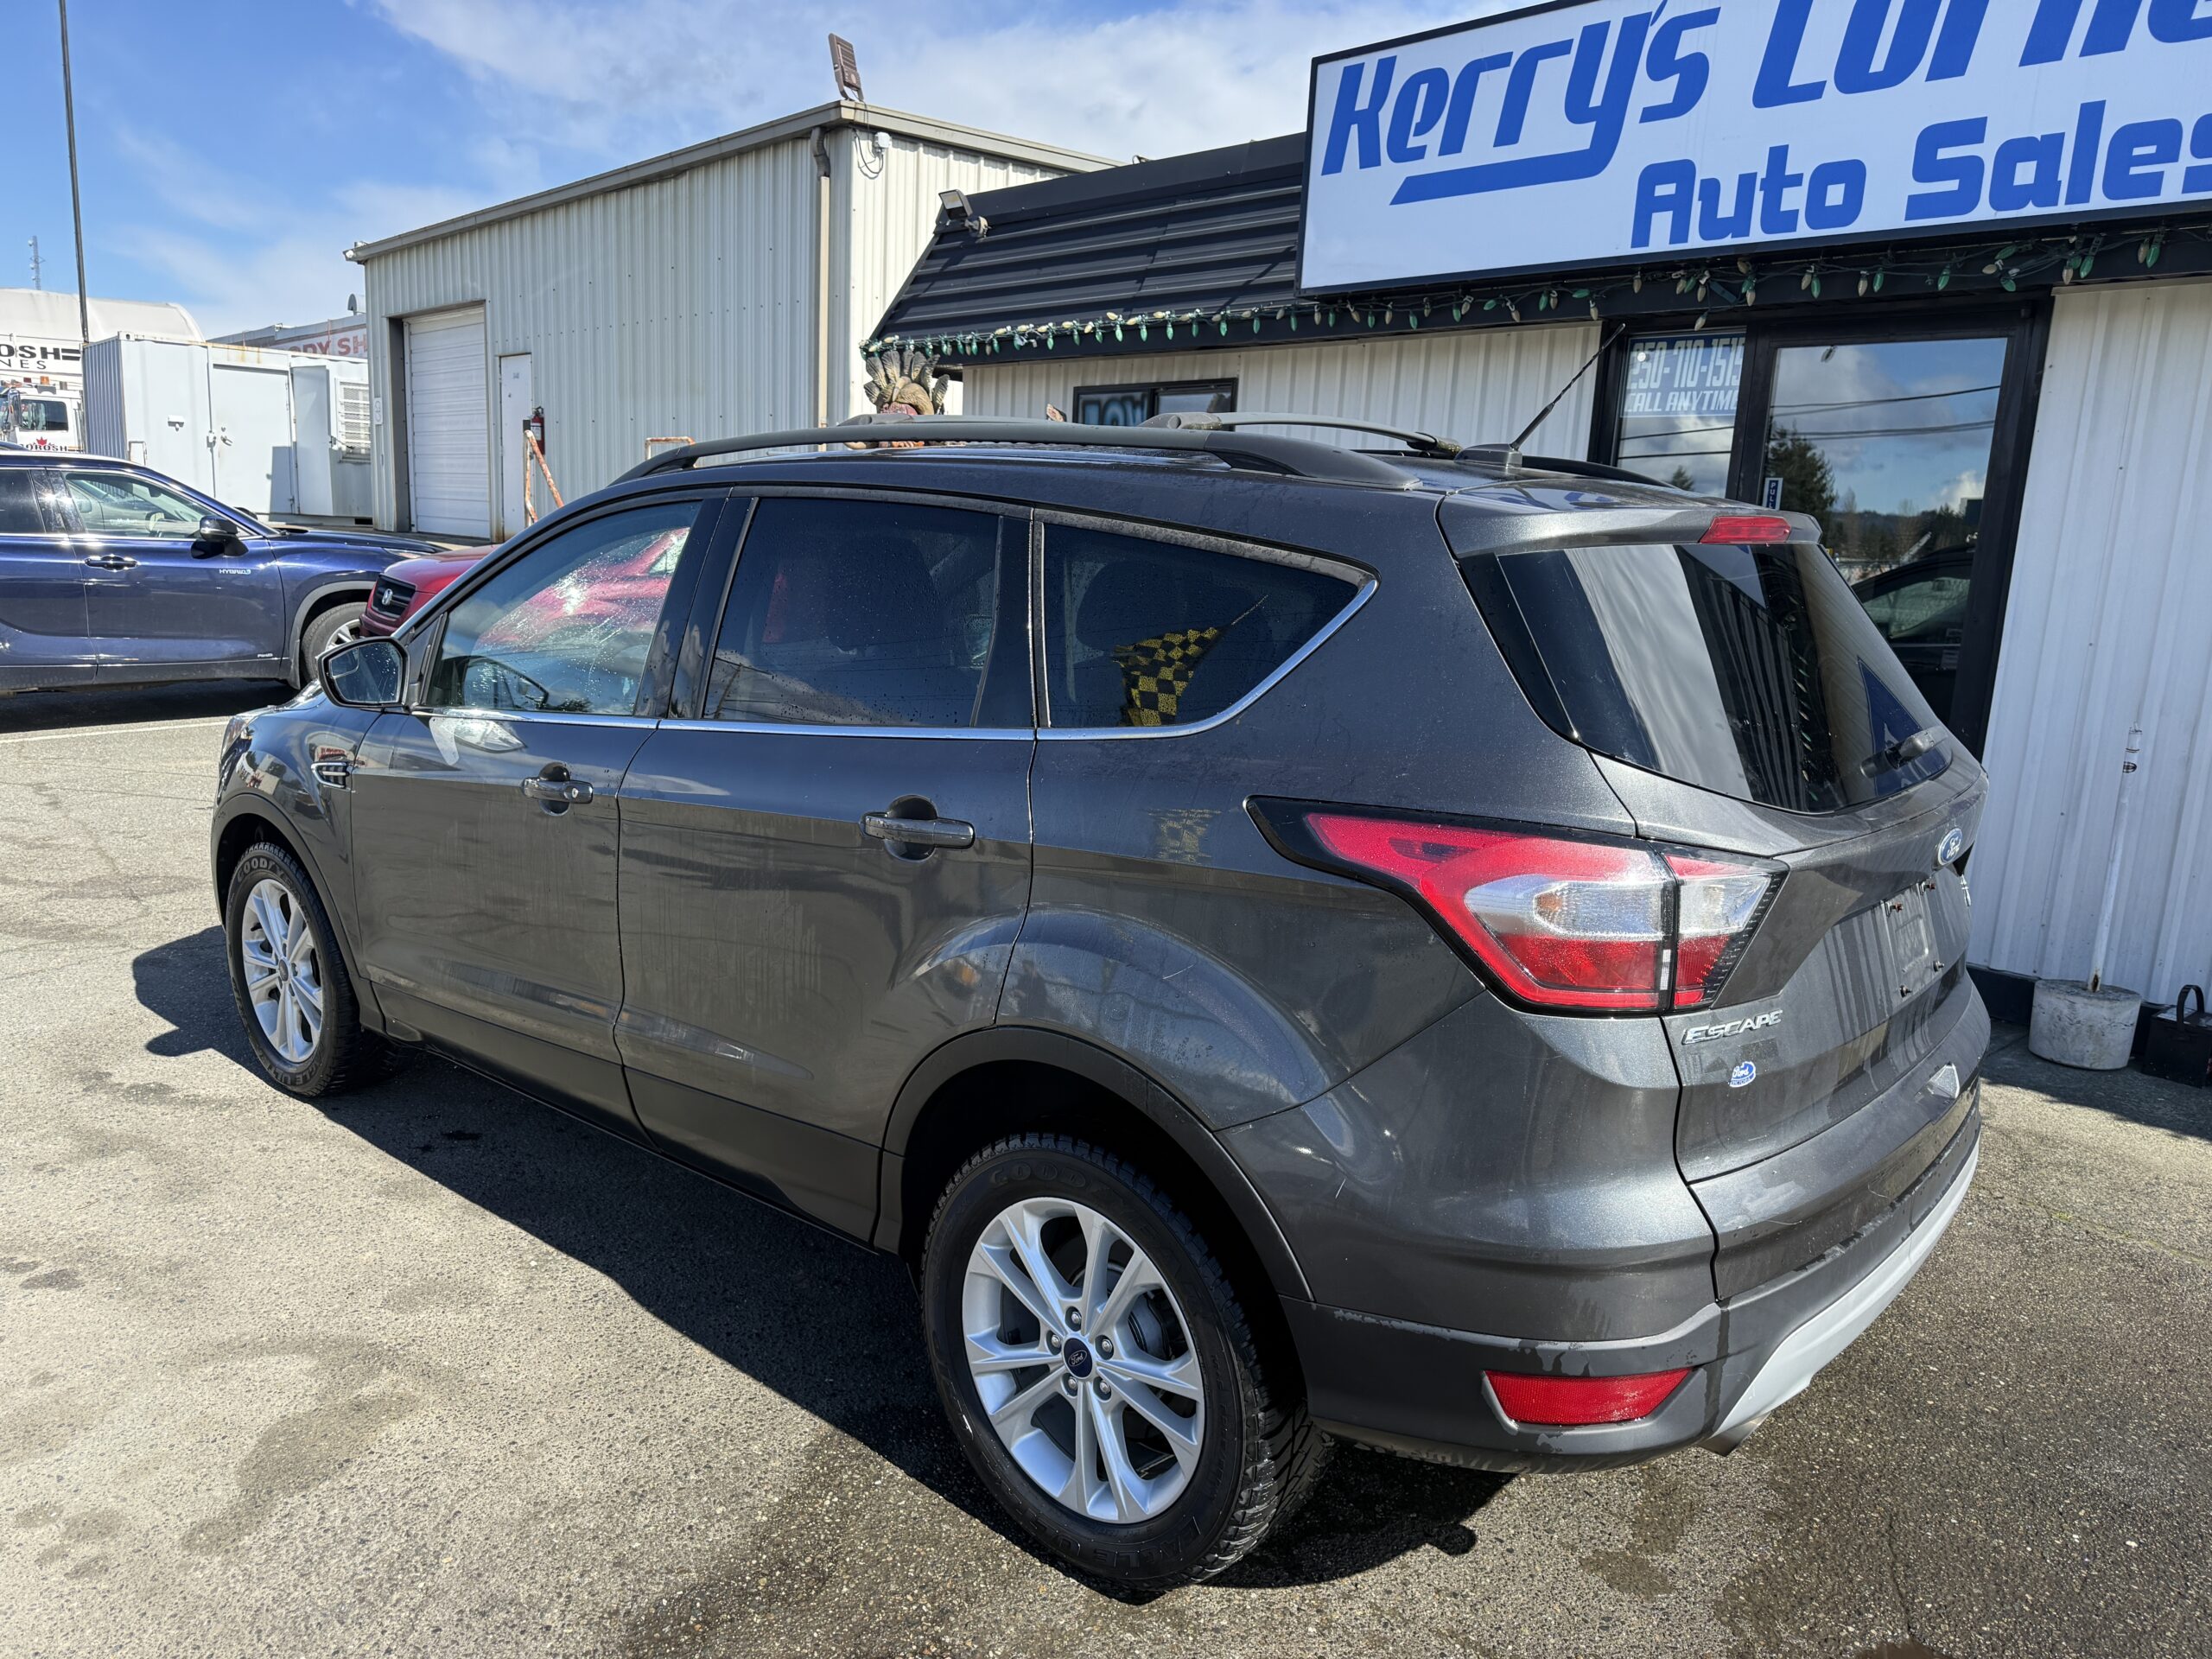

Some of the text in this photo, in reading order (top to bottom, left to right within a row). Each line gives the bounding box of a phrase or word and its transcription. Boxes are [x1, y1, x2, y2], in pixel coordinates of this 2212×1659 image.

[1321, 0, 1720, 206] Kerry's
[1630, 144, 1866, 249] Auto
[1624, 391, 1662, 412] CALL
[20, 442, 67, 452] OROSH
[1682, 1009, 1783, 1045] ESCAPE
